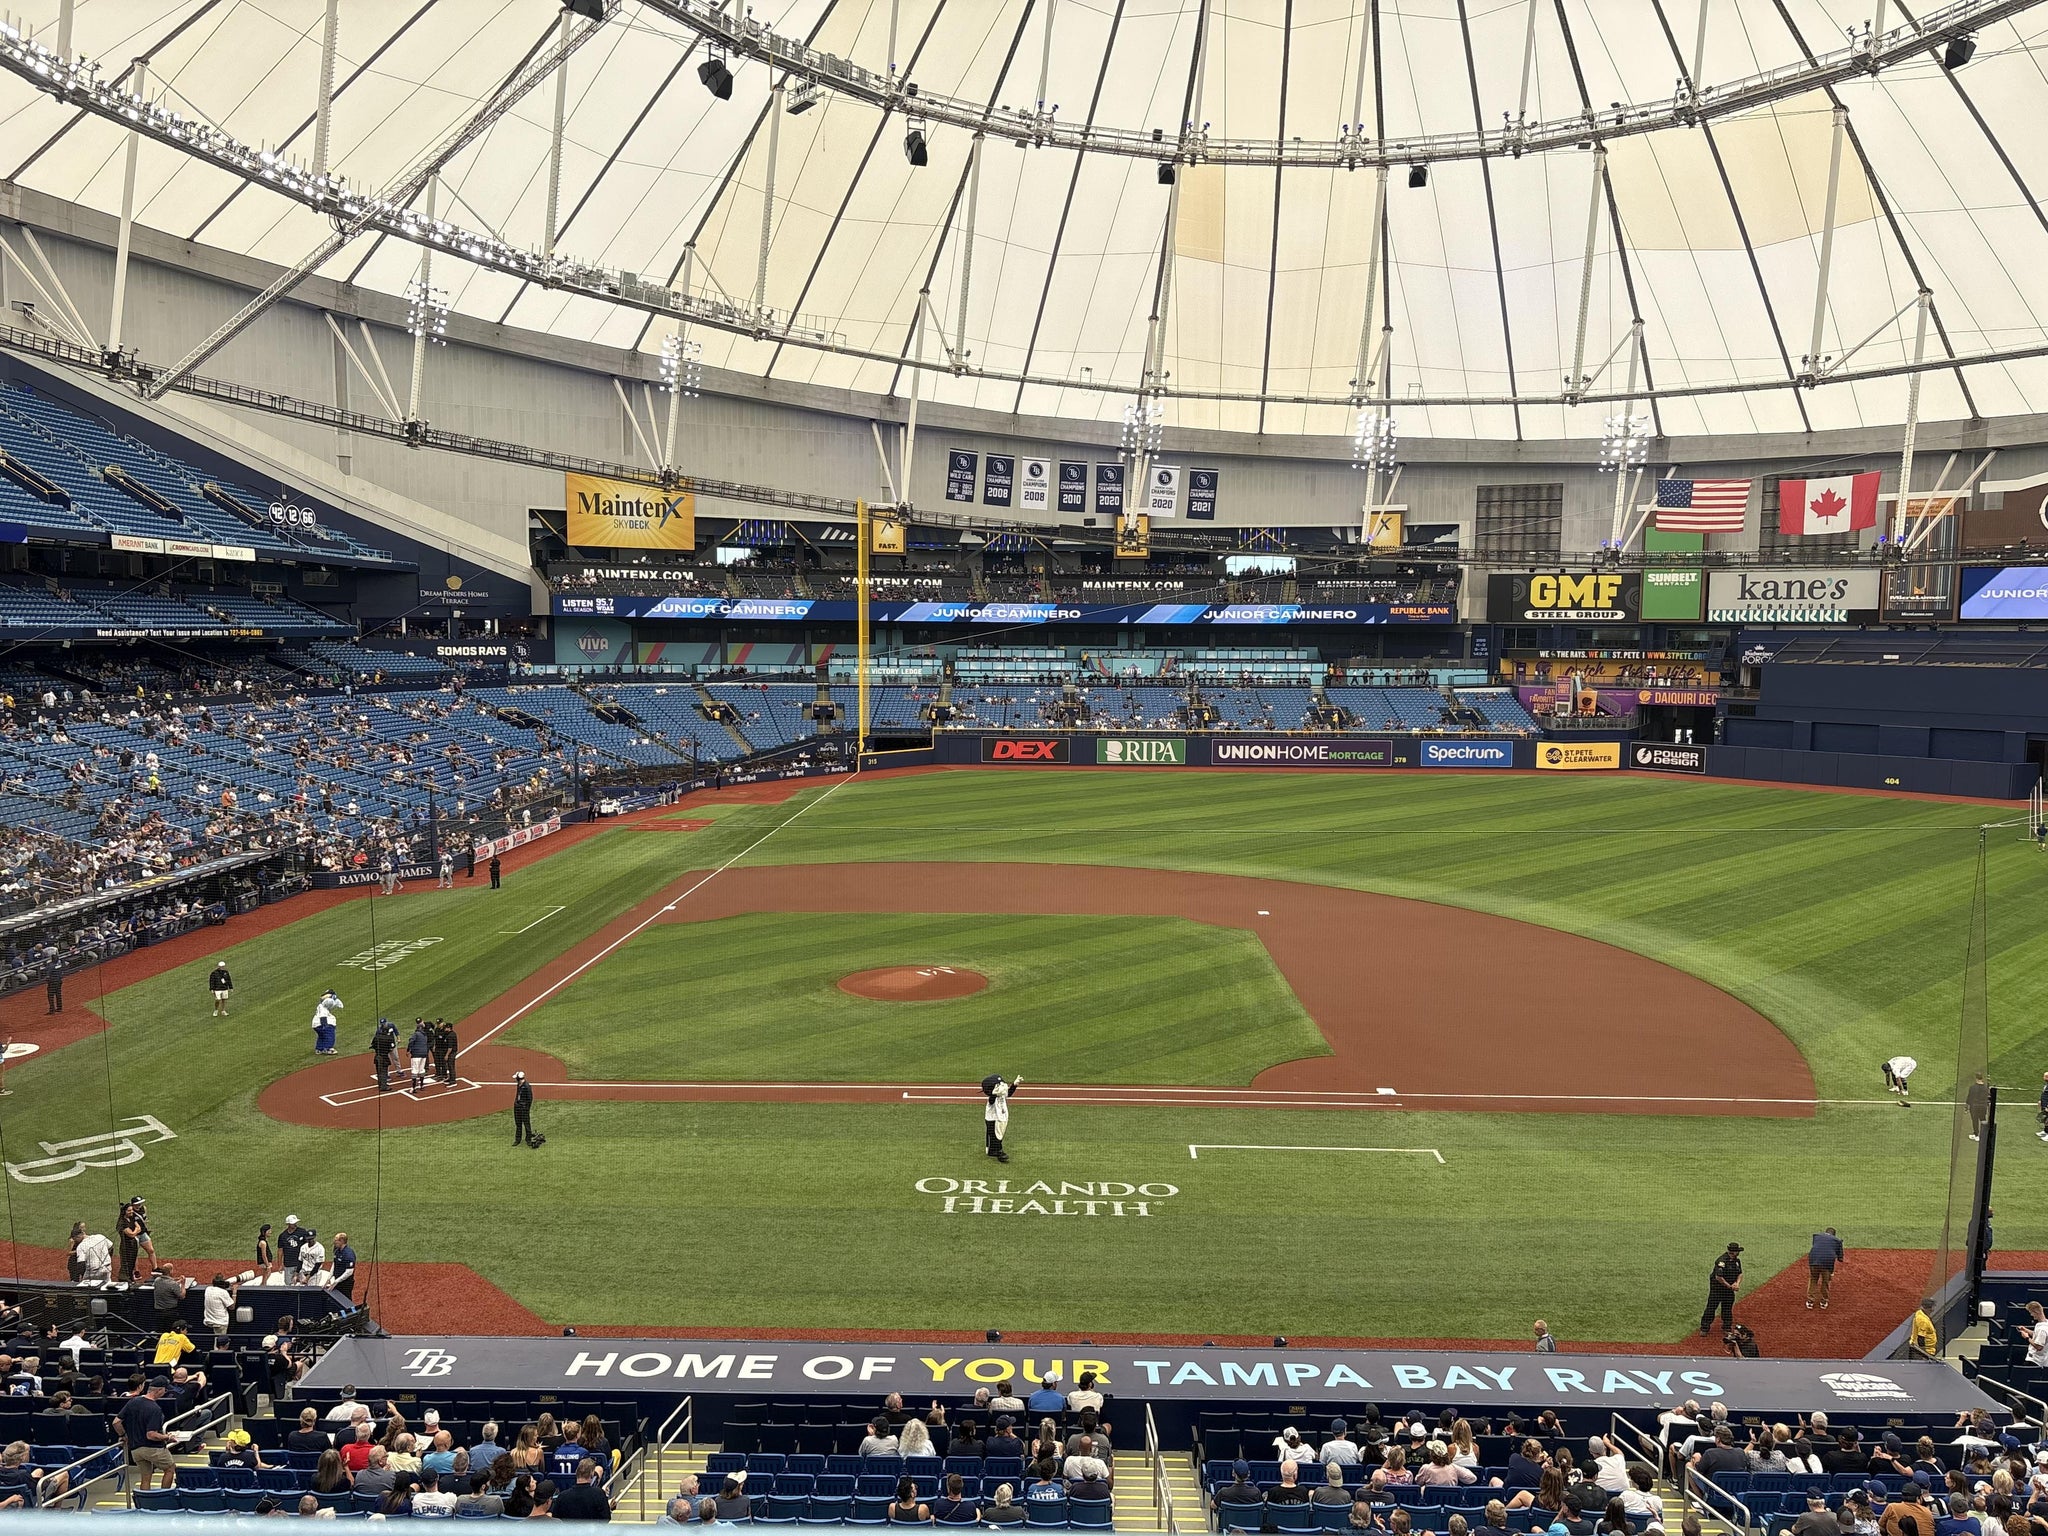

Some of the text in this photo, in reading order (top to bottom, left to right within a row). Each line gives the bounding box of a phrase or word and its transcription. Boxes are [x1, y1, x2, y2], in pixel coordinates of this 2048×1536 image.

[988, 487, 1008, 498] 2008
[1024, 491, 1044, 501] 2008
[1063, 494, 1081, 504] 2010
[1100, 496, 1120, 506] 2020
[1152, 499, 1172, 509] 2020
[271, 506, 282, 519] 42
[576, 492, 685, 528] MaintenX
[1192, 502, 1210, 512] 2021
[288, 509, 297, 521] 12
[302, 512, 314, 524] 66
[614, 519, 650, 529] SKYDECK
[118, 540, 158, 550] AMERANT BANK
[1083, 581, 1183, 590] MAINTENX.COM
[1737, 574, 1848, 600] kane's
[1530, 575, 1622, 608] GMF
[1981, 590, 2048, 598] JUNIOR
[652, 604, 808, 615] JUNIOR CAMINERO
[933, 608, 1081, 618] JUNIOR CAMINERO
[1203, 611, 1357, 619] JUNIOR CAMINERO
[97, 629, 112, 637] Need
[114, 629, 148, 637] Assistance?
[150, 629, 162, 637] Text
[164, 629, 175, 637] Your
[176, 629, 190, 637] Issue
[191, 629, 200, 637] and
[202, 629, 222, 637] Location
[223, 629, 229, 637] to
[579, 638, 608, 650] VIVA
[437, 646, 507, 656] SOMOS RAYS
[1655, 692, 1717, 705] DAIQUIRI DEC
[993, 741, 1059, 759] DEX
[1125, 741, 1178, 762] RIPA
[1429, 746, 1500, 761] Spectrum
[338, 873, 379, 885] RAYMO
[915, 1177, 1179, 1197] ORLANDO
[401, 1348, 1725, 1397] TB HOME OF YOUR TAMPA BAY RAYS
[1820, 1380, 1904, 1391] Tropicana
[560, 1462, 571, 1474] 11
